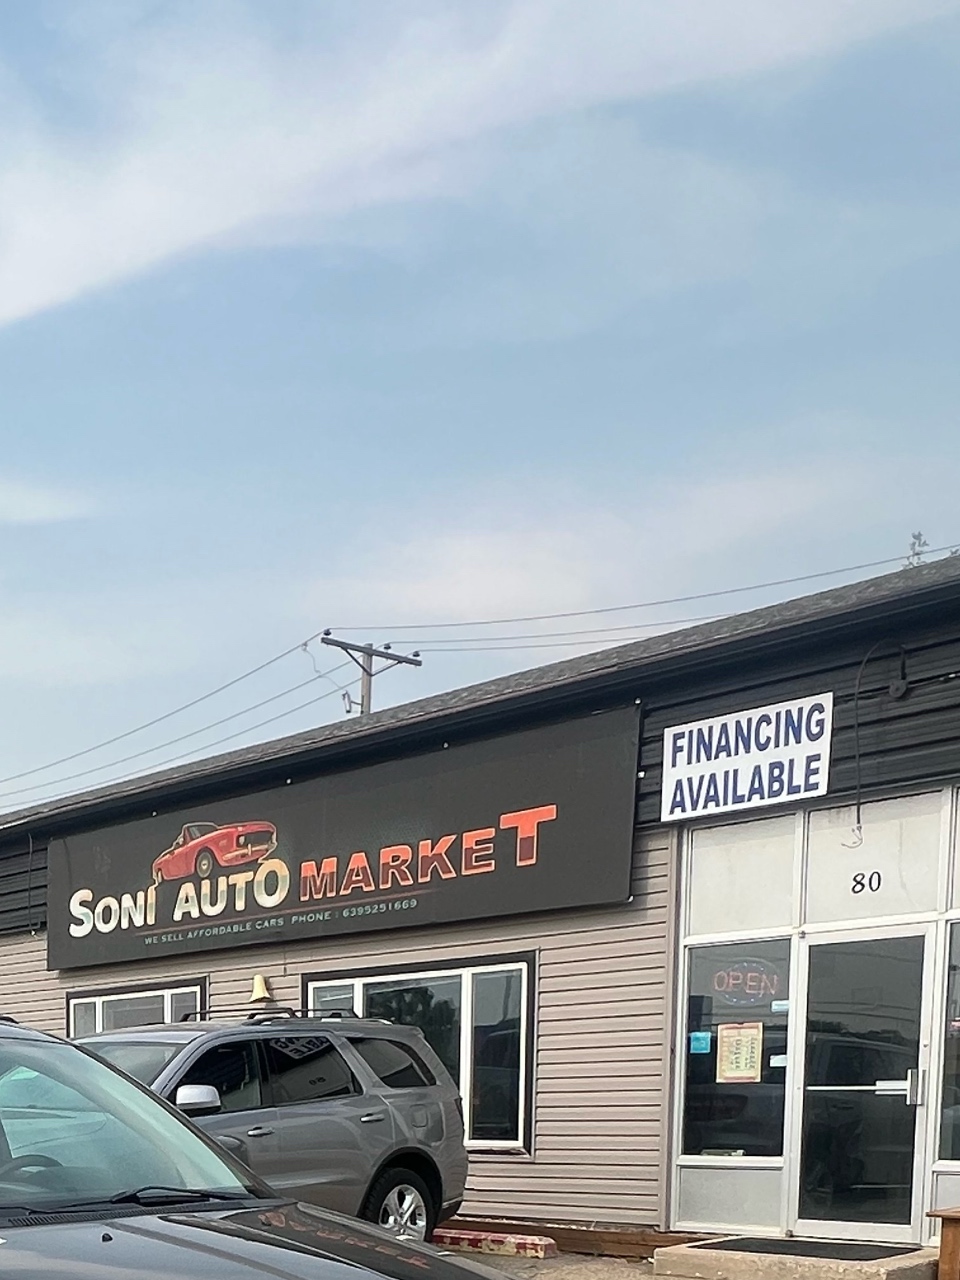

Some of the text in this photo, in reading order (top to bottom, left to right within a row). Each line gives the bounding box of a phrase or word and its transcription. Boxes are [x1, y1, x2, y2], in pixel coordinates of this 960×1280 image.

[671, 703, 825, 768] FINANCING
[669, 753, 821, 815] AVAILABLE
[69, 805, 557, 938] SONI AUTO MARKET
[851, 871, 881, 894] 80
[144, 935, 159, 945] WE
[161, 933, 184, 943] SELL
[187, 922, 252, 939] AFFORDABLE
[255, 917, 285, 929] CARS
[291, 911, 331, 924] PHONE
[714, 971, 778, 996] OPEN
